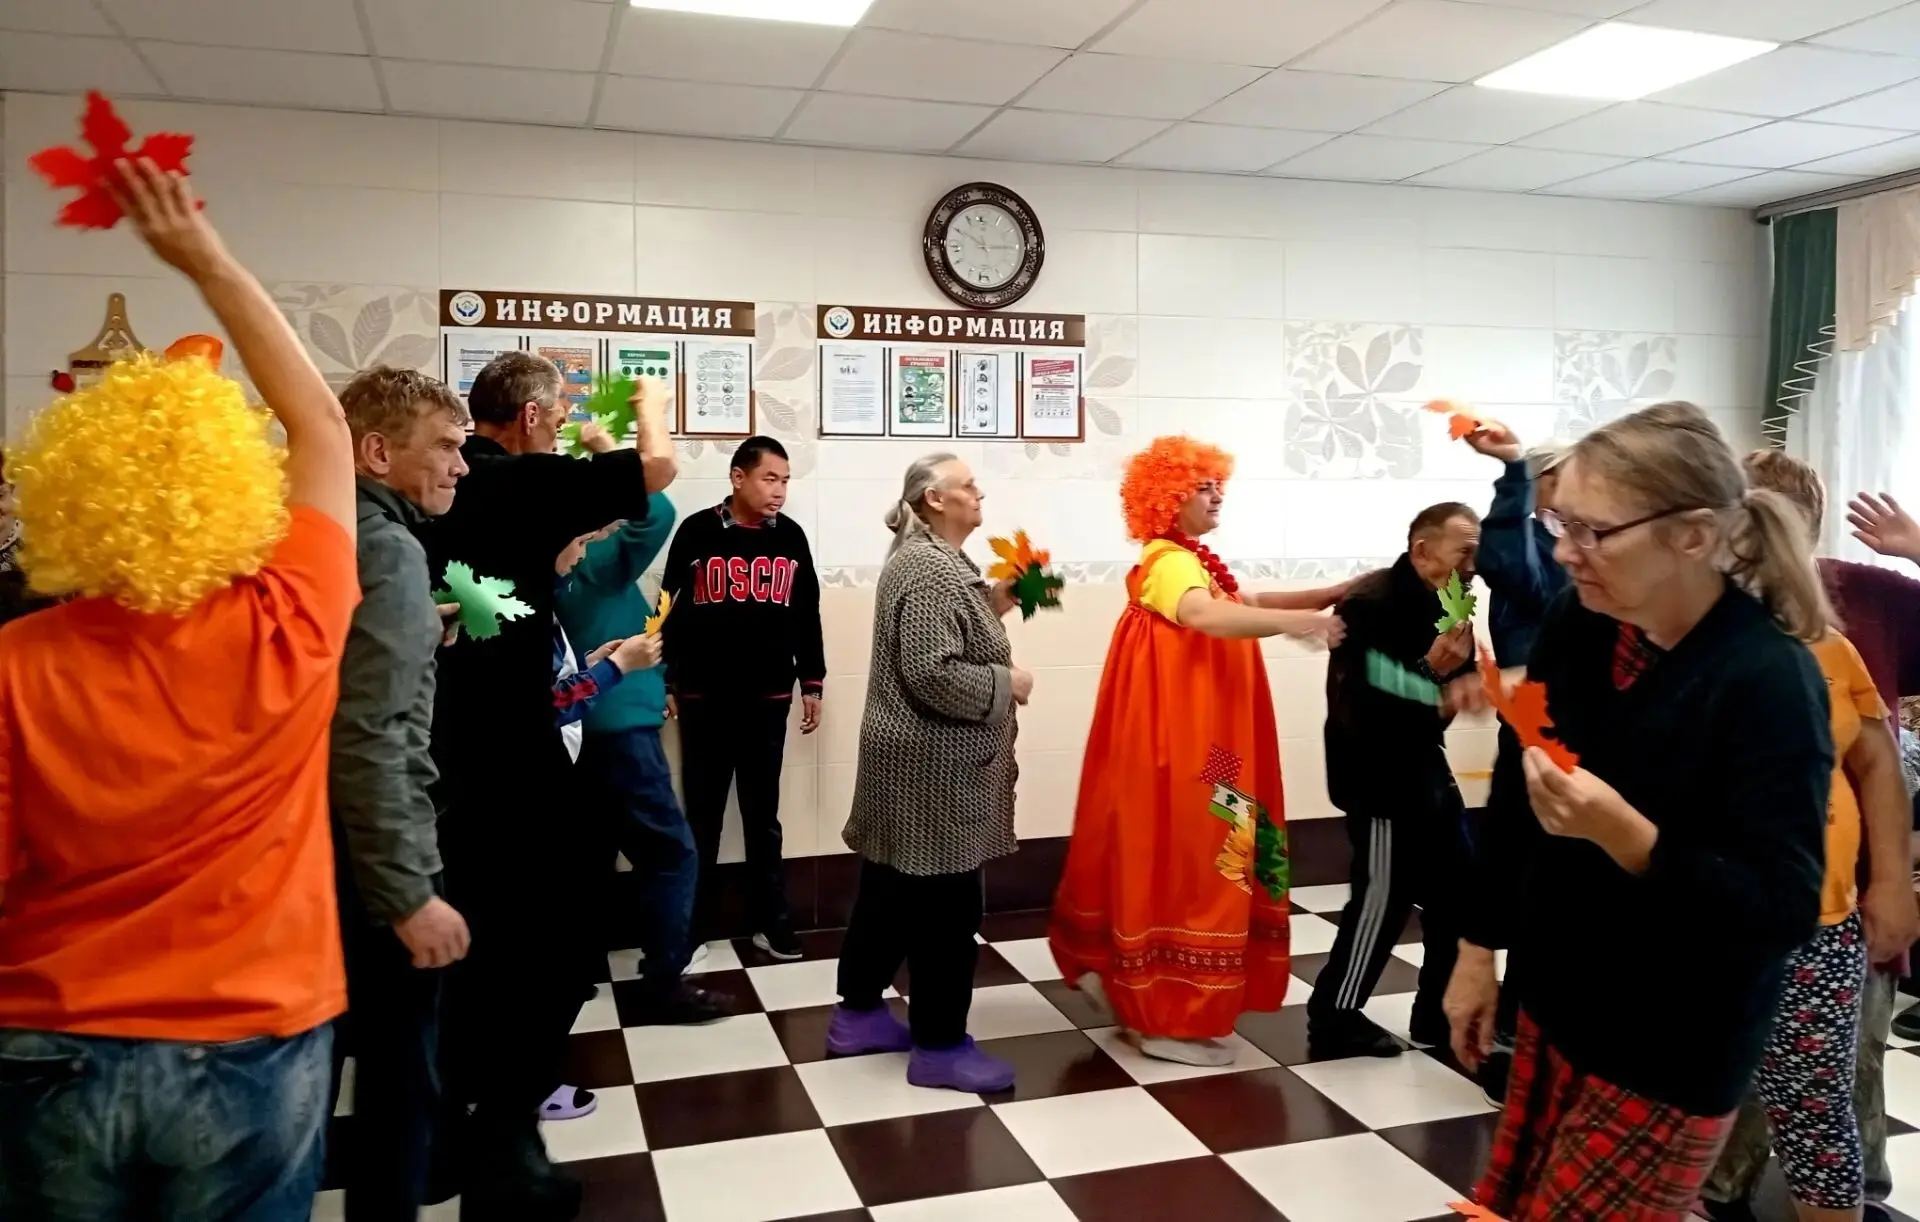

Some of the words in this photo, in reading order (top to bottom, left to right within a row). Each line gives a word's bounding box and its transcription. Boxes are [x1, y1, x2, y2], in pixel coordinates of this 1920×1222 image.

[496, 300, 732, 329] ИНФОРМАЦИЯ
[864, 313, 1064, 341] ИНФОРМАЦИЯ
[690, 556, 798, 606] OSCO
